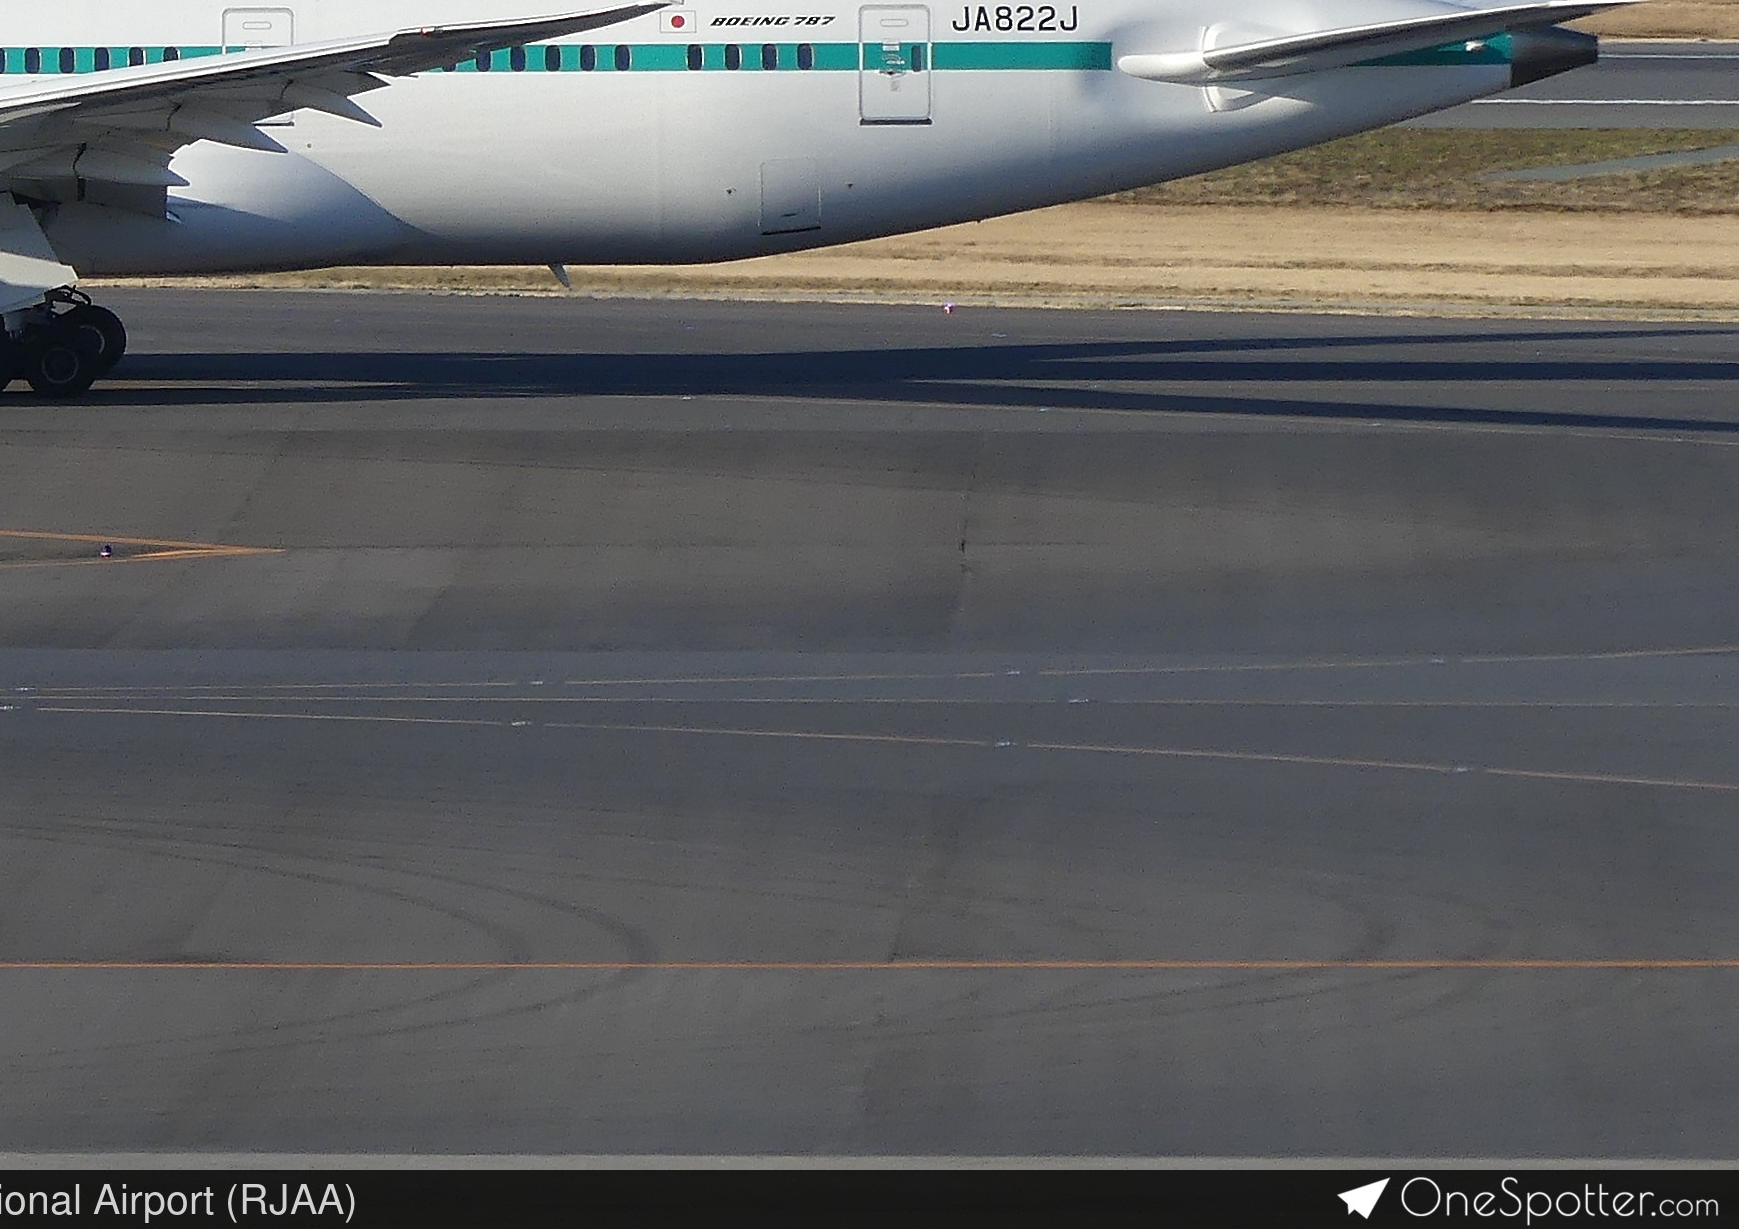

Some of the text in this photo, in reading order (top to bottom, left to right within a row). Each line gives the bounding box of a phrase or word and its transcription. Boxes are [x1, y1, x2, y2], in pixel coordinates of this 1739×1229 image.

[710, 16, 836, 27] BOEING 787
[952, 6, 1078, 32] JA822J
